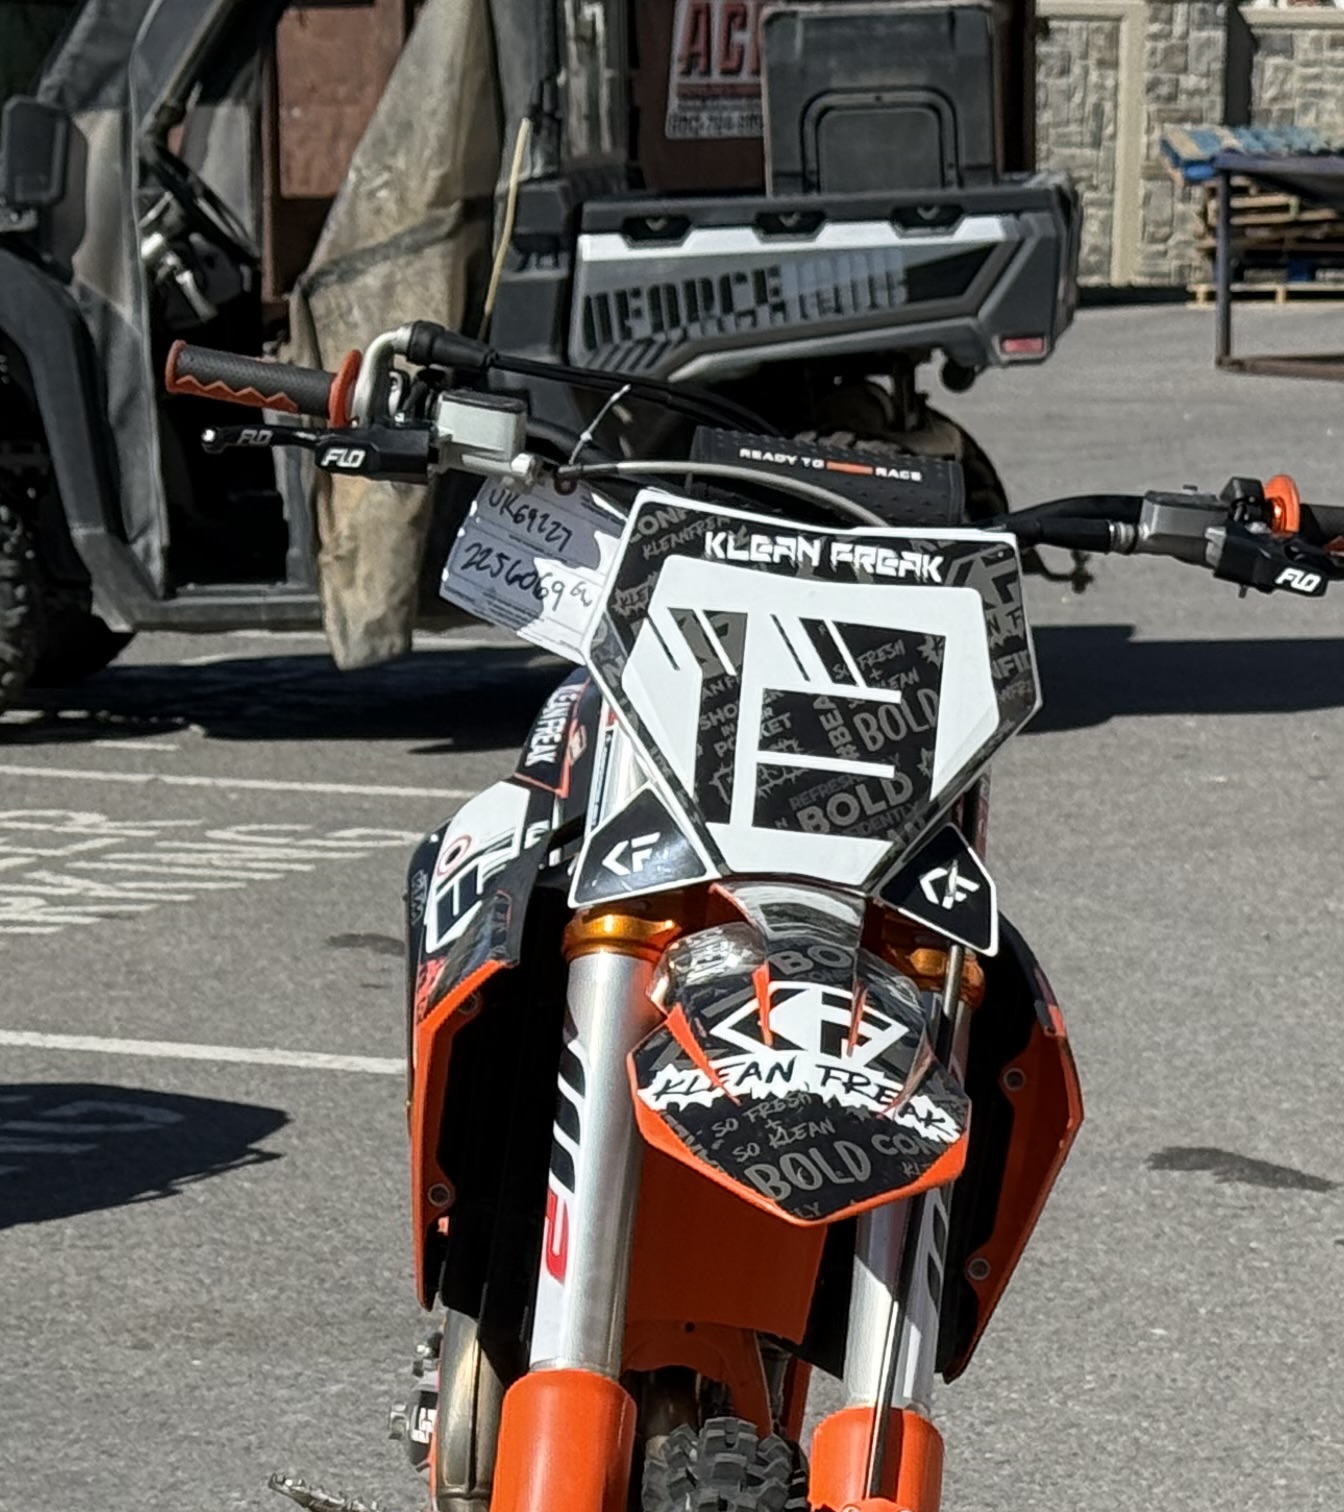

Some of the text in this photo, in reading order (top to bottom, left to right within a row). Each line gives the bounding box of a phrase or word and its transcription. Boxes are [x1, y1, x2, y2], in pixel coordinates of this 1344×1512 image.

[679, 0, 761, 76] AC
[236, 429, 274, 445] FLO
[320, 447, 367, 469] FLO
[738, 447, 923, 482] READY TO RACE
[703, 530, 944, 583] KLEAN FREAK
[1274, 566, 1323, 593] FLO
[852, 688, 940, 753] BOLD
[710, 1116, 740, 1138] SO
[732, 1116, 837, 1163] SO KLEAN
[743, 1140, 873, 1203] BOLD
